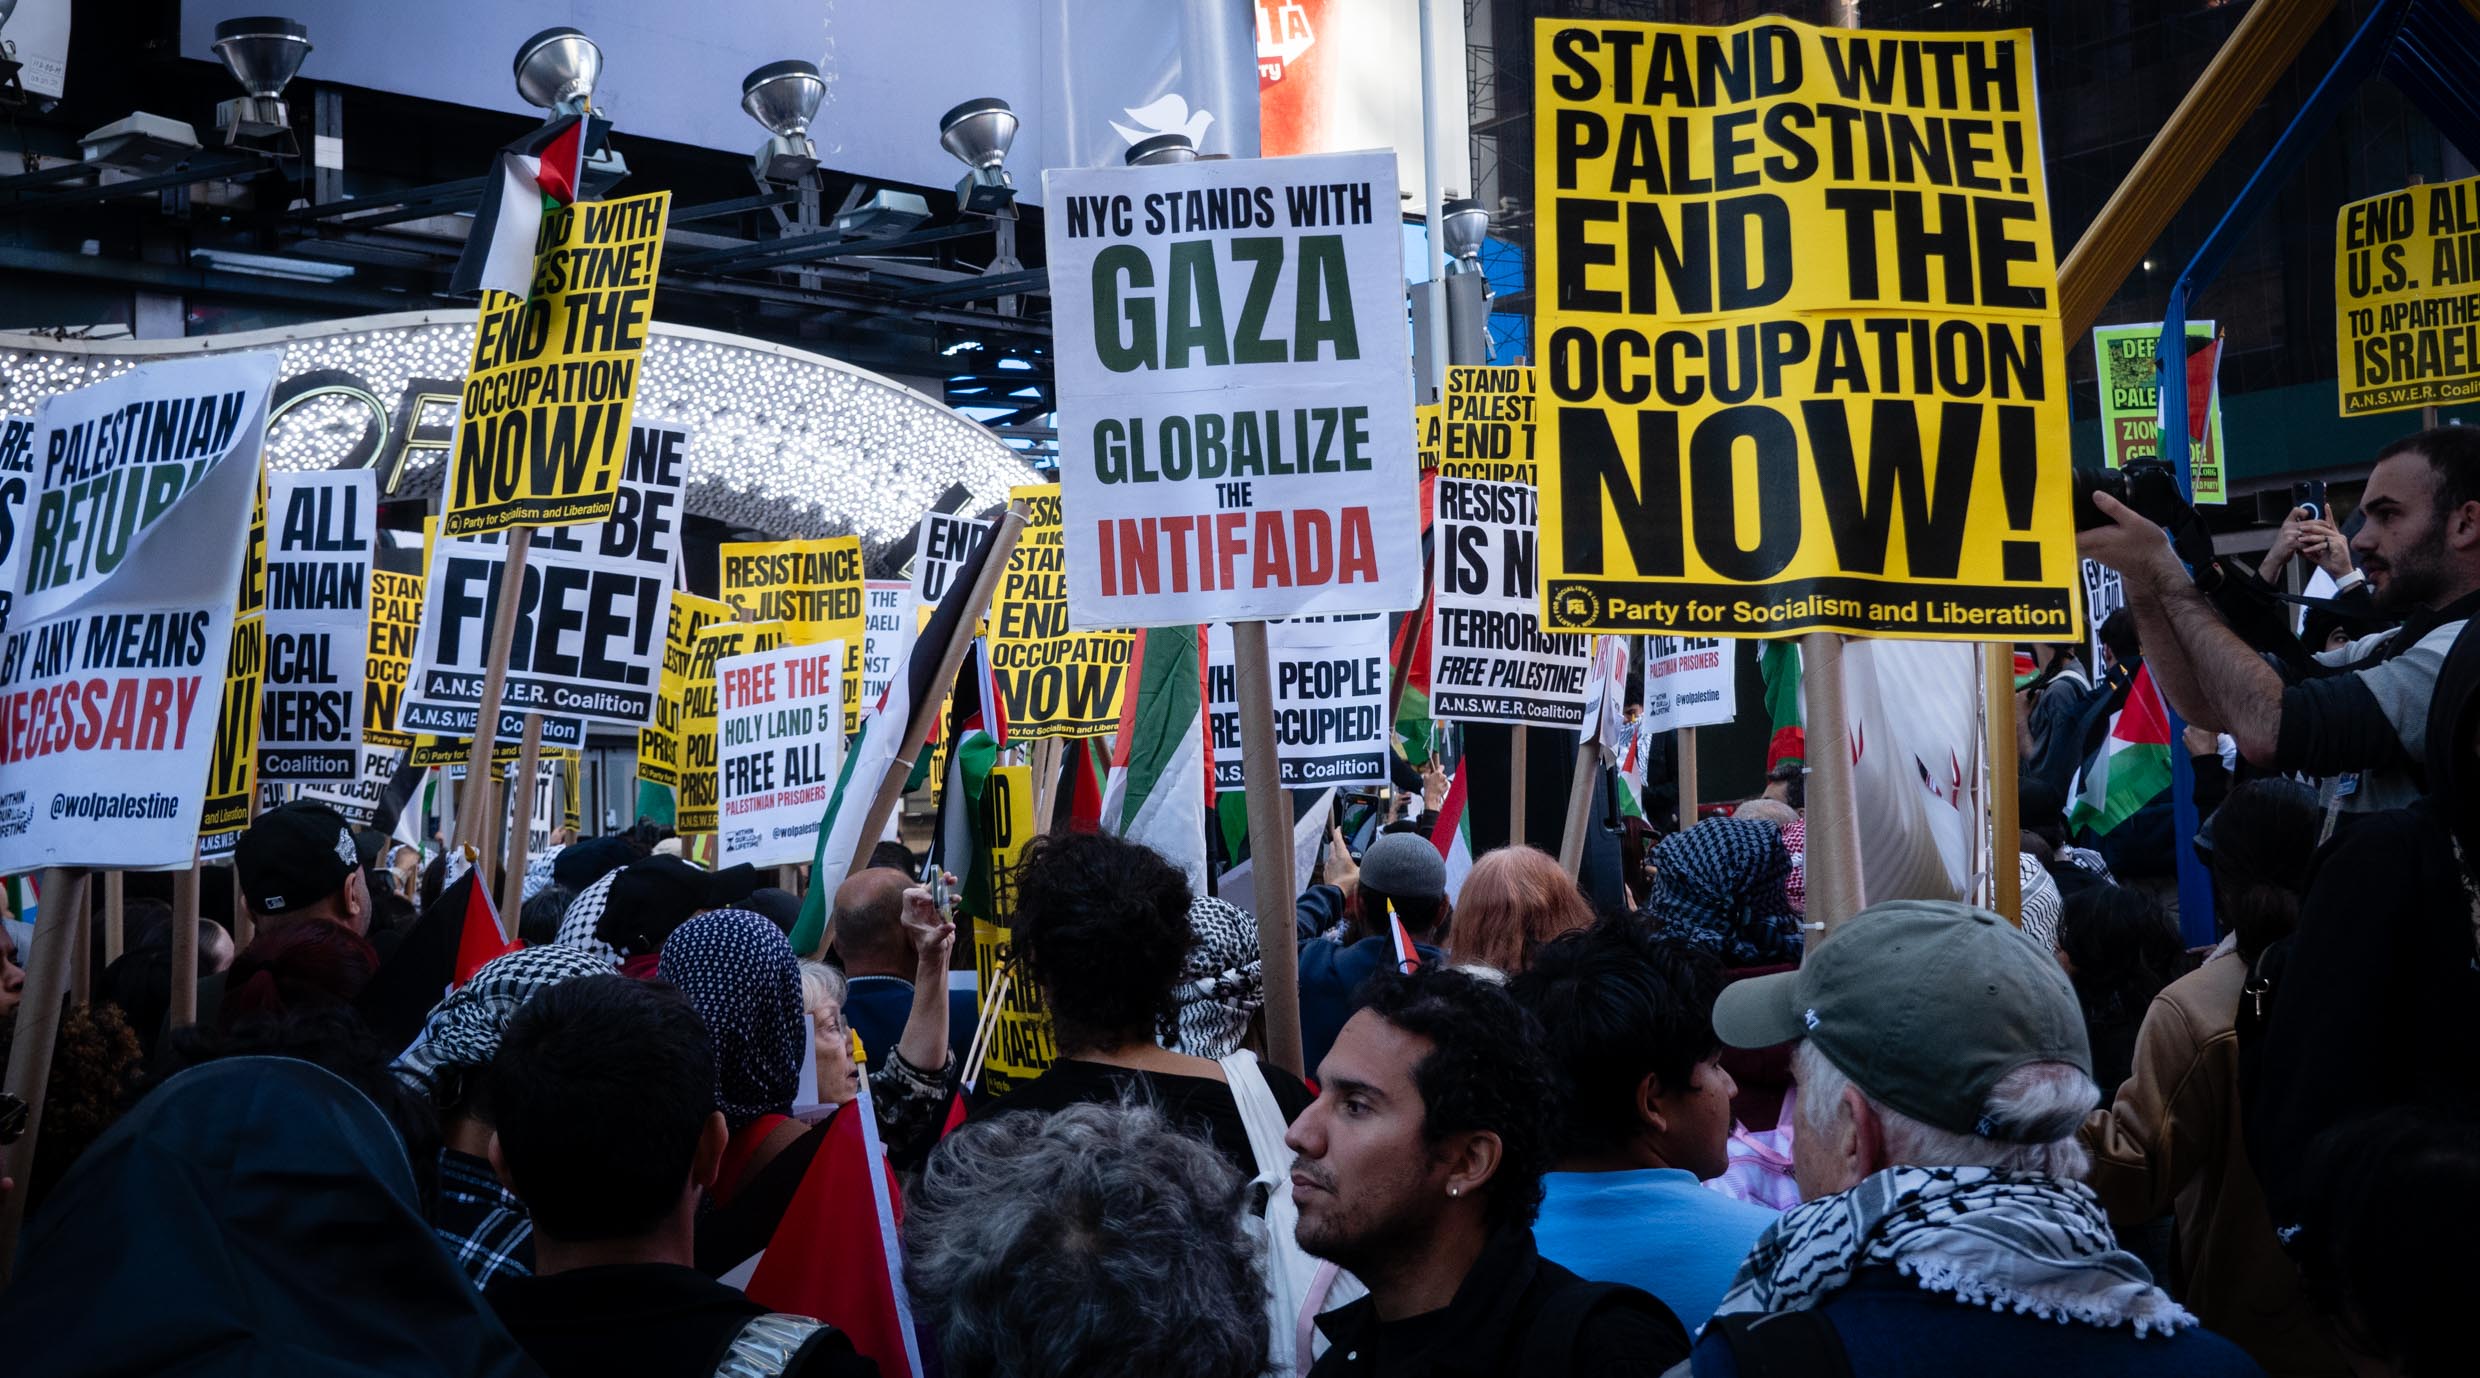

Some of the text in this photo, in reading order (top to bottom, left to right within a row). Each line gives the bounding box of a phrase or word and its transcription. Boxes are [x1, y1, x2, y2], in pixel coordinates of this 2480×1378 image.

[1551, 24, 2020, 113] STAND WITH
[1555, 102, 2028, 195] PALESTINE!
[584, 196, 664, 244] WITH
[1066, 183, 1372, 238] NYC STANDS WITH
[2346, 193, 2414, 250] END
[1555, 188, 2047, 316] END THE
[2348, 243, 2419, 299] U.S.
[1091, 234, 1360, 373] GAZA
[2348, 307, 2374, 338] TO
[474, 288, 650, 373] END THE
[2122, 338, 2161, 358] DEF
[1549, 318, 2045, 407] OCCUPATION
[2354, 325, 2480, 388] ISRAEL
[464, 358, 634, 421] OCCUPATION
[1448, 368, 1520, 393] STAND
[2350, 385, 2437, 409] A.N.S.W.E.R.
[1448, 395, 1537, 422] PALEST
[43, 390, 246, 490] PALESTINIAN
[454, 402, 623, 509] NOW!
[622, 426, 686, 488] NE
[1093, 406, 1372, 485] GLOBALIZE
[1446, 422, 1512, 460] END
[1215, 482, 1253, 509] THE
[1558, 398, 2043, 583] NOW!
[280, 485, 367, 551] ALL
[463, 517, 486, 530] Party
[486, 514, 499, 525] for
[542, 506, 563, 519] and
[563, 502, 610, 517] Liberation
[599, 486, 675, 564] BE
[725, 548, 860, 589] RESISTANCE
[1097, 506, 1379, 597] INTIFADA
[1444, 525, 1538, 600] IS N
[434, 557, 662, 686] FREE!
[753, 587, 861, 622] JUSTIFIED
[871, 591, 898, 608] THE
[999, 601, 1069, 640] END
[1608, 594, 2066, 626] Party for Socialism and Liberation
[1, 630, 31, 687] BY
[30, 618, 81, 680] ANY
[82, 611, 210, 670] MEANS
[365, 658, 411, 684] OCC
[1679, 651, 1719, 673] PRISONERS
[724, 663, 776, 710] FREE
[784, 655, 831, 699] THE
[994, 664, 1130, 722] NOW
[1278, 657, 1382, 700] PEOPLE
[1436, 655, 1489, 687] FREE
[1488, 658, 1587, 694] PALESTINE!
[553, 688, 645, 716] Coalition
[1439, 697, 1526, 716] A.N.S.W.E.R.
[1527, 705, 1582, 721] Coalition
[1675, 688, 1720, 707] @wolpalestine
[501, 716, 575, 739] Cotion
[725, 713, 763, 748] HOLY
[768, 706, 812, 740] LAND
[818, 704, 829, 732] 5
[1022, 727, 1035, 736] for
[1036, 724, 1075, 735] Socialism
[1077, 725, 1093, 734] and
[265, 755, 349, 773] Coalition
[725, 743, 826, 798] FREE ALL
[1302, 759, 1379, 778] Coalition
[50, 792, 179, 822] @wolpalestine
[725, 785, 826, 817] PALESTINIAN PRISONERS
